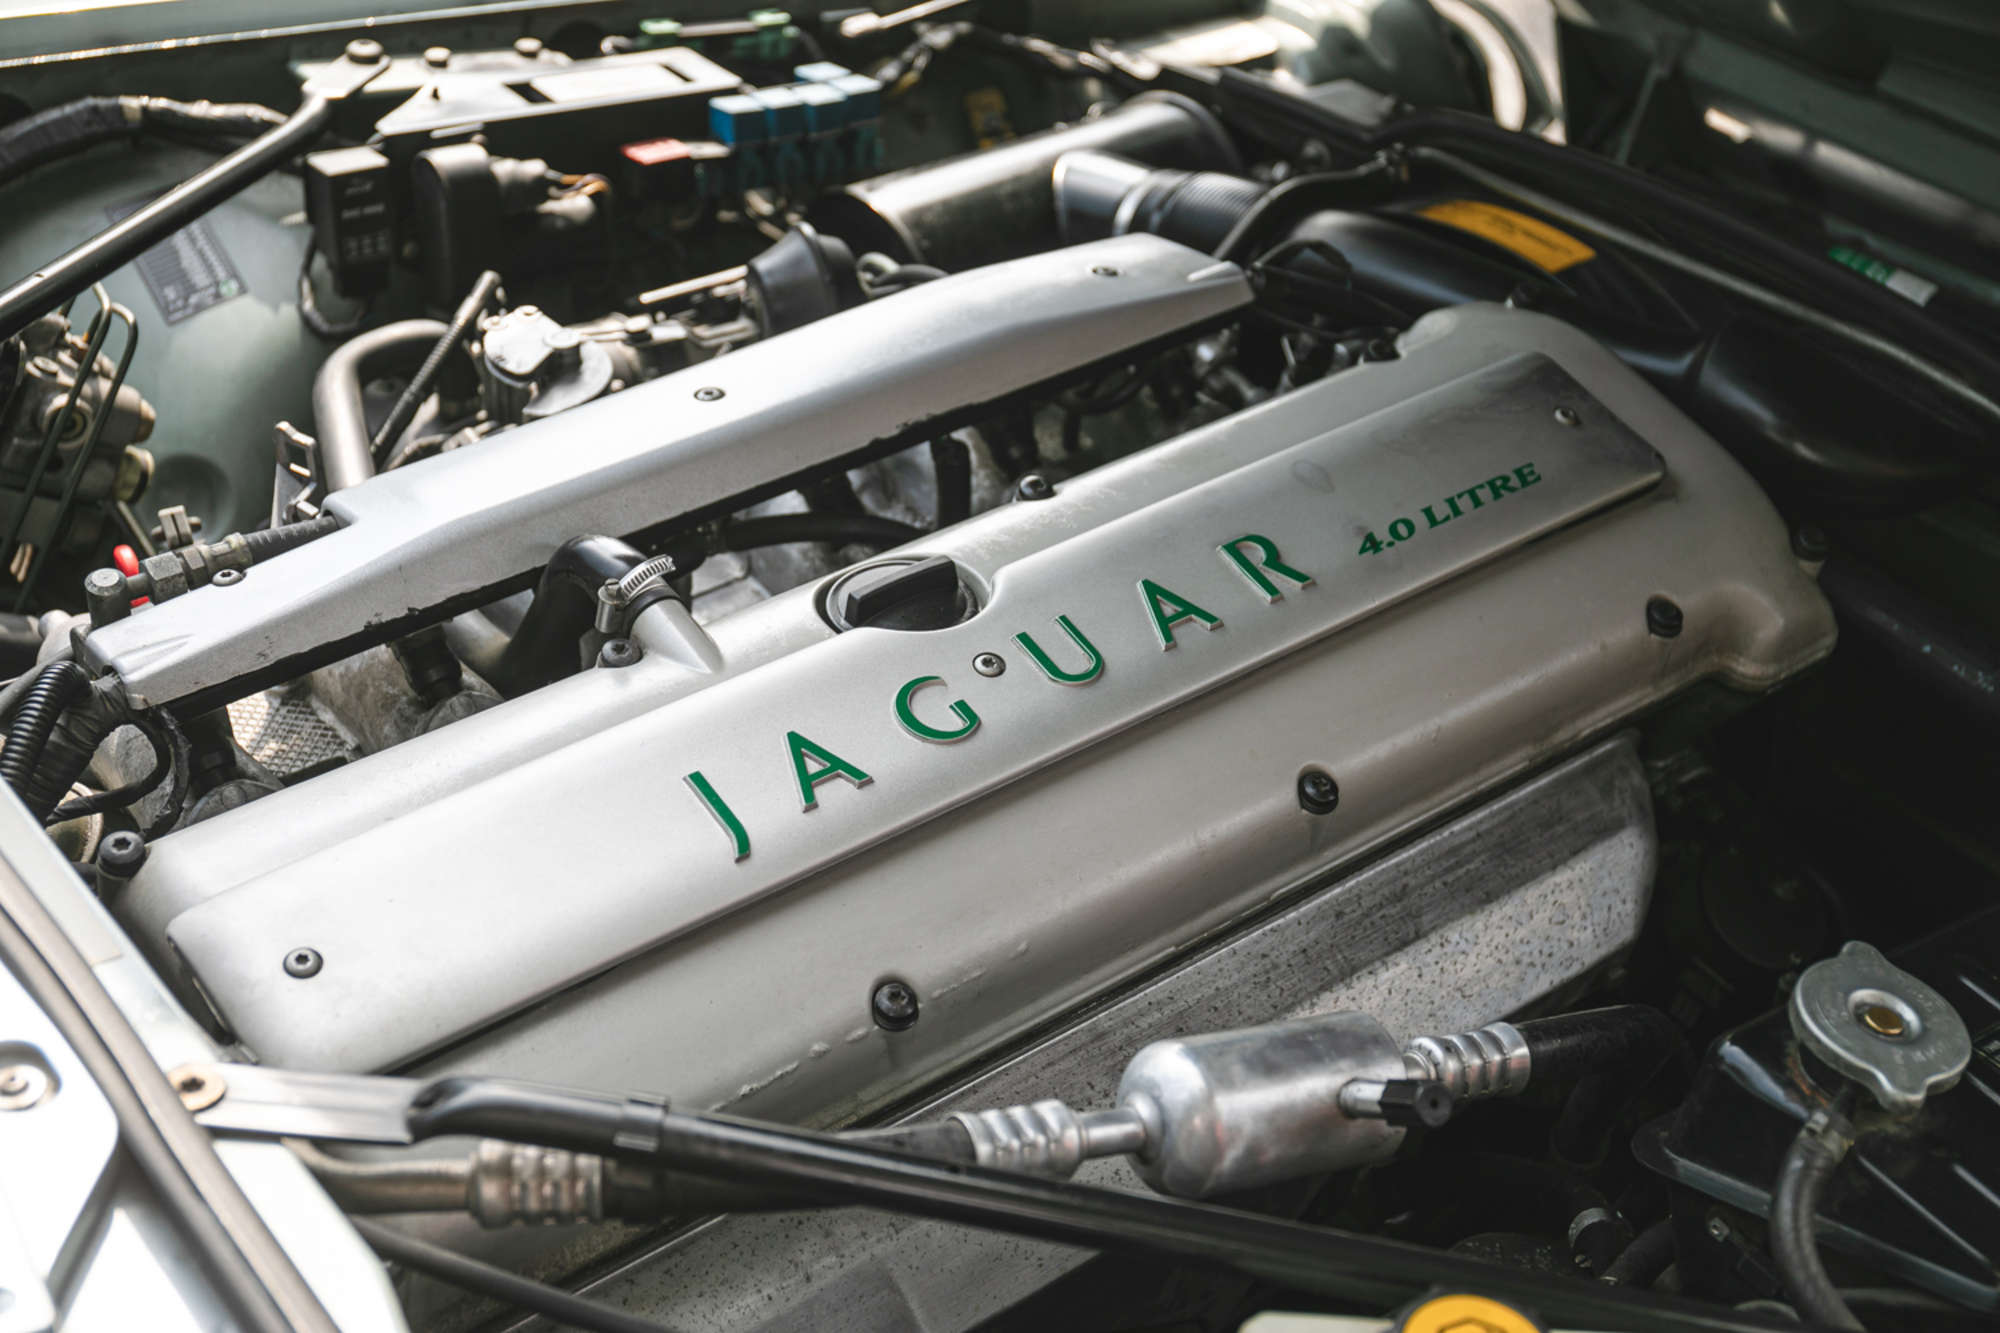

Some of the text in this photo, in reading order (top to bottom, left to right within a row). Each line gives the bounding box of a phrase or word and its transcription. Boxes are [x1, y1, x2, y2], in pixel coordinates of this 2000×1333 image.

[1358, 462, 1542, 555] 4.0 LITRE
[684, 533, 1314, 862] JAGUAR
